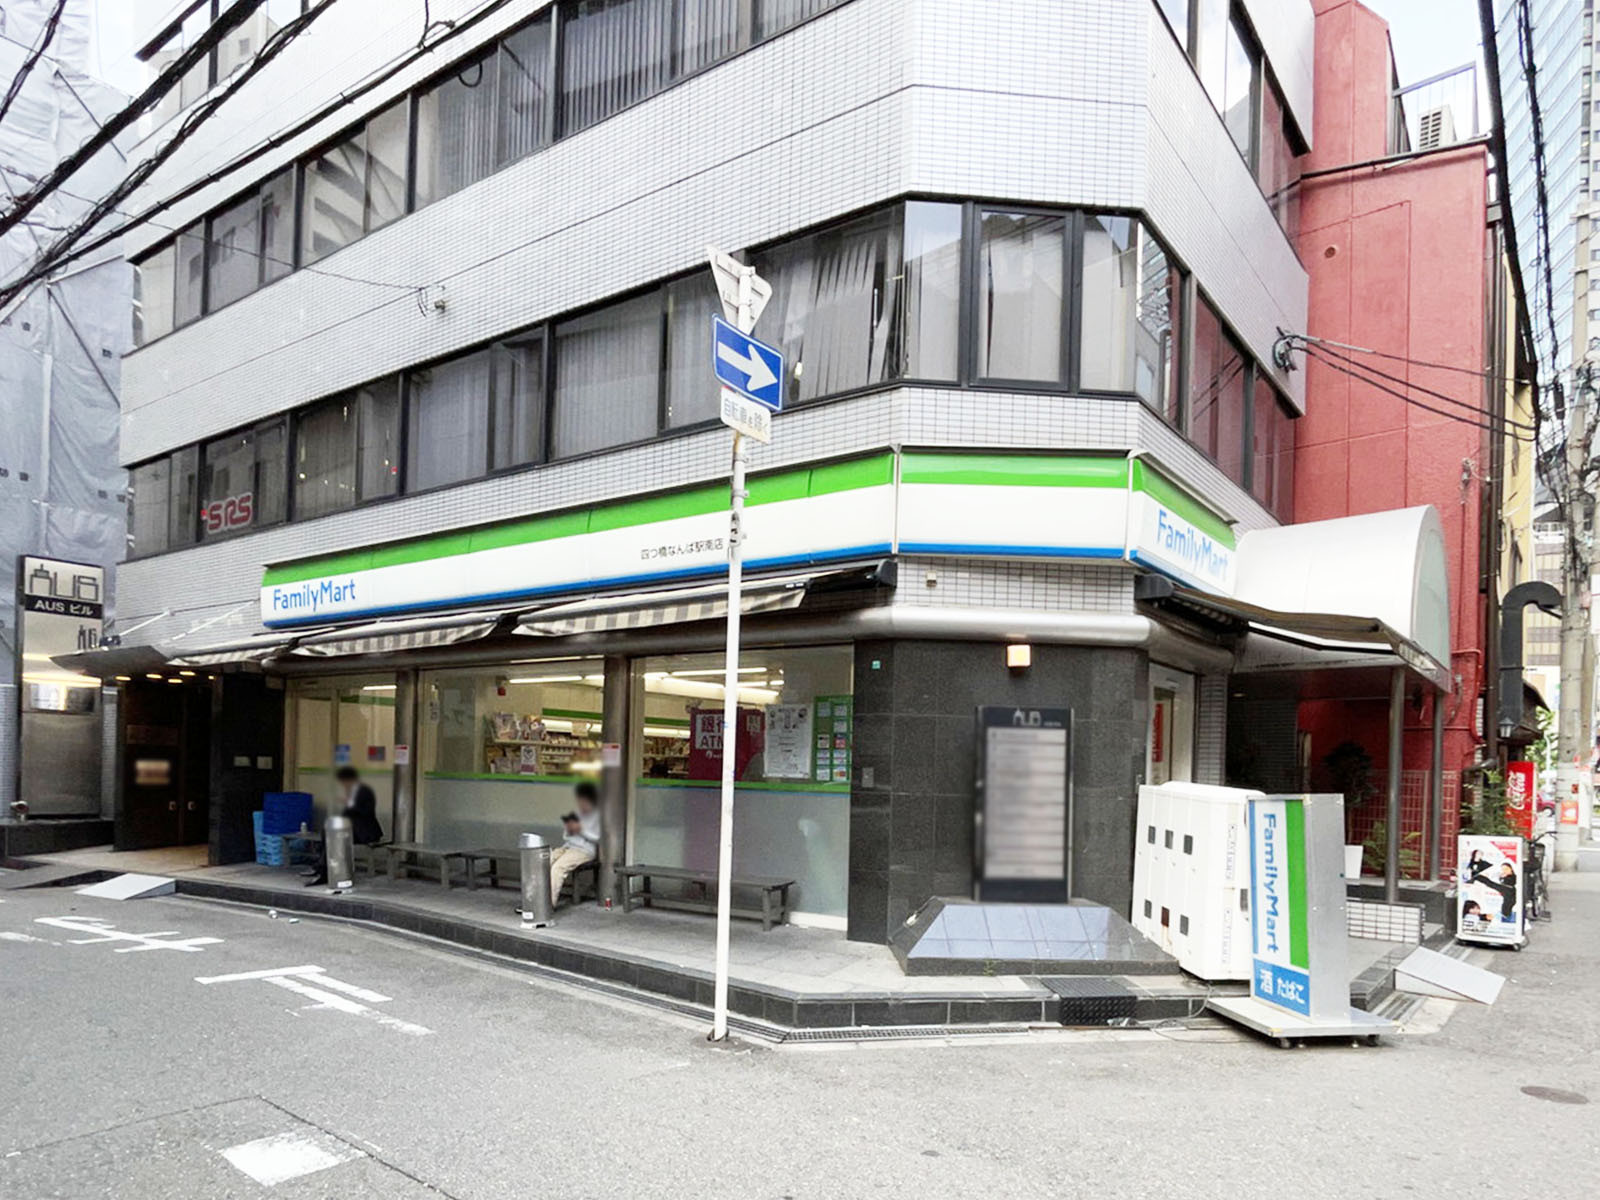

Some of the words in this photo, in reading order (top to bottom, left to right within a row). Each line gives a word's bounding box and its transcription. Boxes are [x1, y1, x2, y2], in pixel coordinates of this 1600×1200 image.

[207, 493, 253, 532] SRS
[1157, 508, 1229, 582] FamilyMart
[34, 600, 65, 612] AUS
[70, 604, 94, 615] ビル
[273, 578, 356, 612] FamilyMart
[1264, 812, 1279, 953] FamilyMart
[1276, 977, 1306, 1004] たばこ
